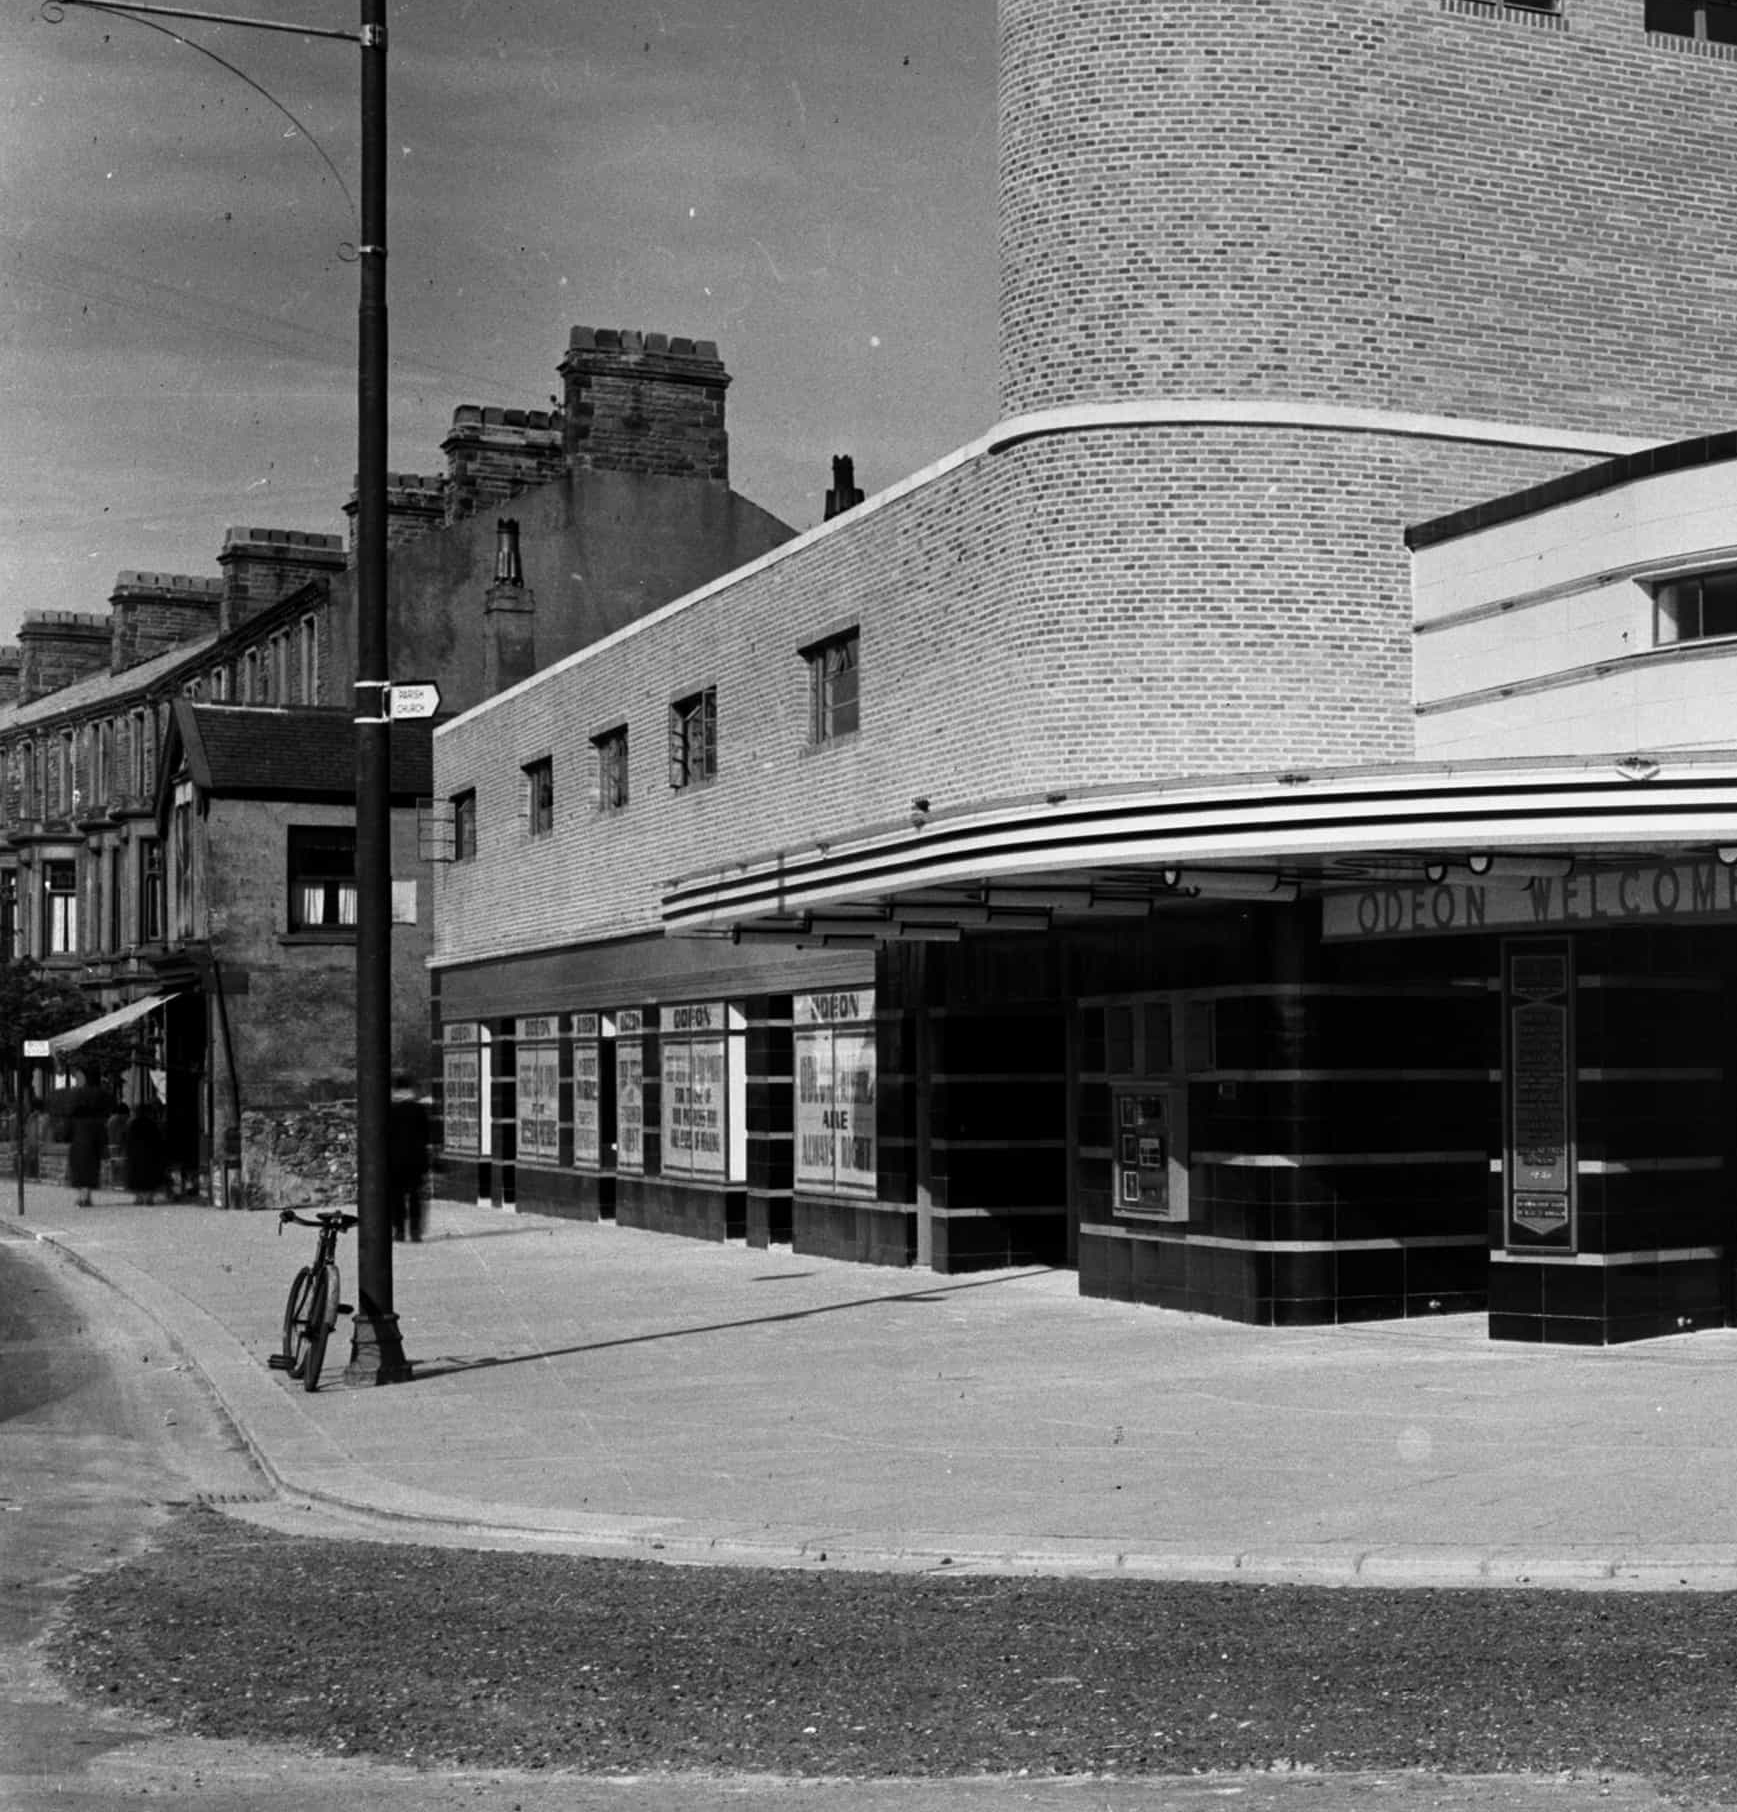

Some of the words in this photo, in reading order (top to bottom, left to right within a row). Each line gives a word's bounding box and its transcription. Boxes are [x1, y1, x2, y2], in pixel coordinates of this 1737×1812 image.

[396, 702, 425, 714] CHURCH
[1358, 884, 1487, 934] ODEON
[822, 1110, 849, 1131] ARE
